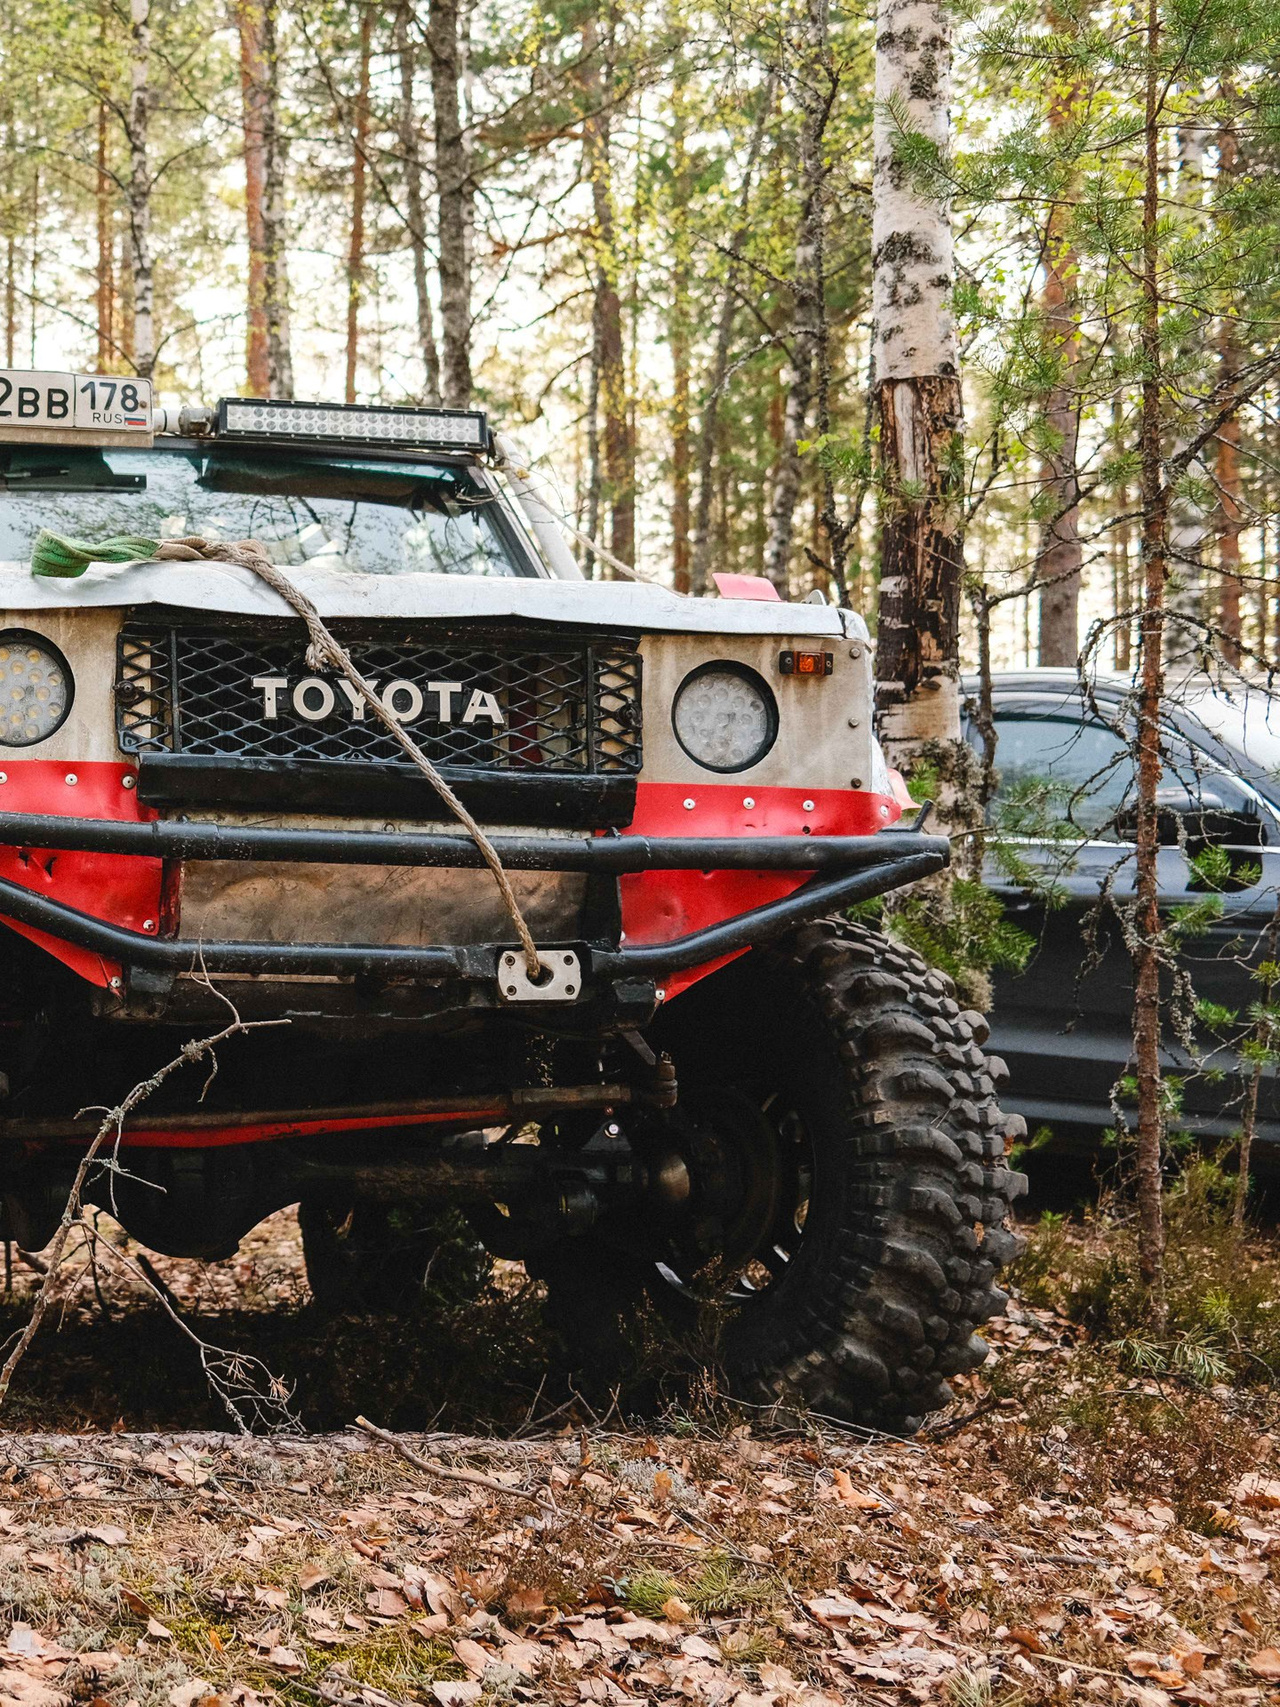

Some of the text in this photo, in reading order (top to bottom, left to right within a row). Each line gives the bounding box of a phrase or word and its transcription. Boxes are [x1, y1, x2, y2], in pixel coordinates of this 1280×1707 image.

[80, 381, 138, 412] 178
[92, 412, 123, 424] RUS
[252, 677, 505, 725] TOYOTA
